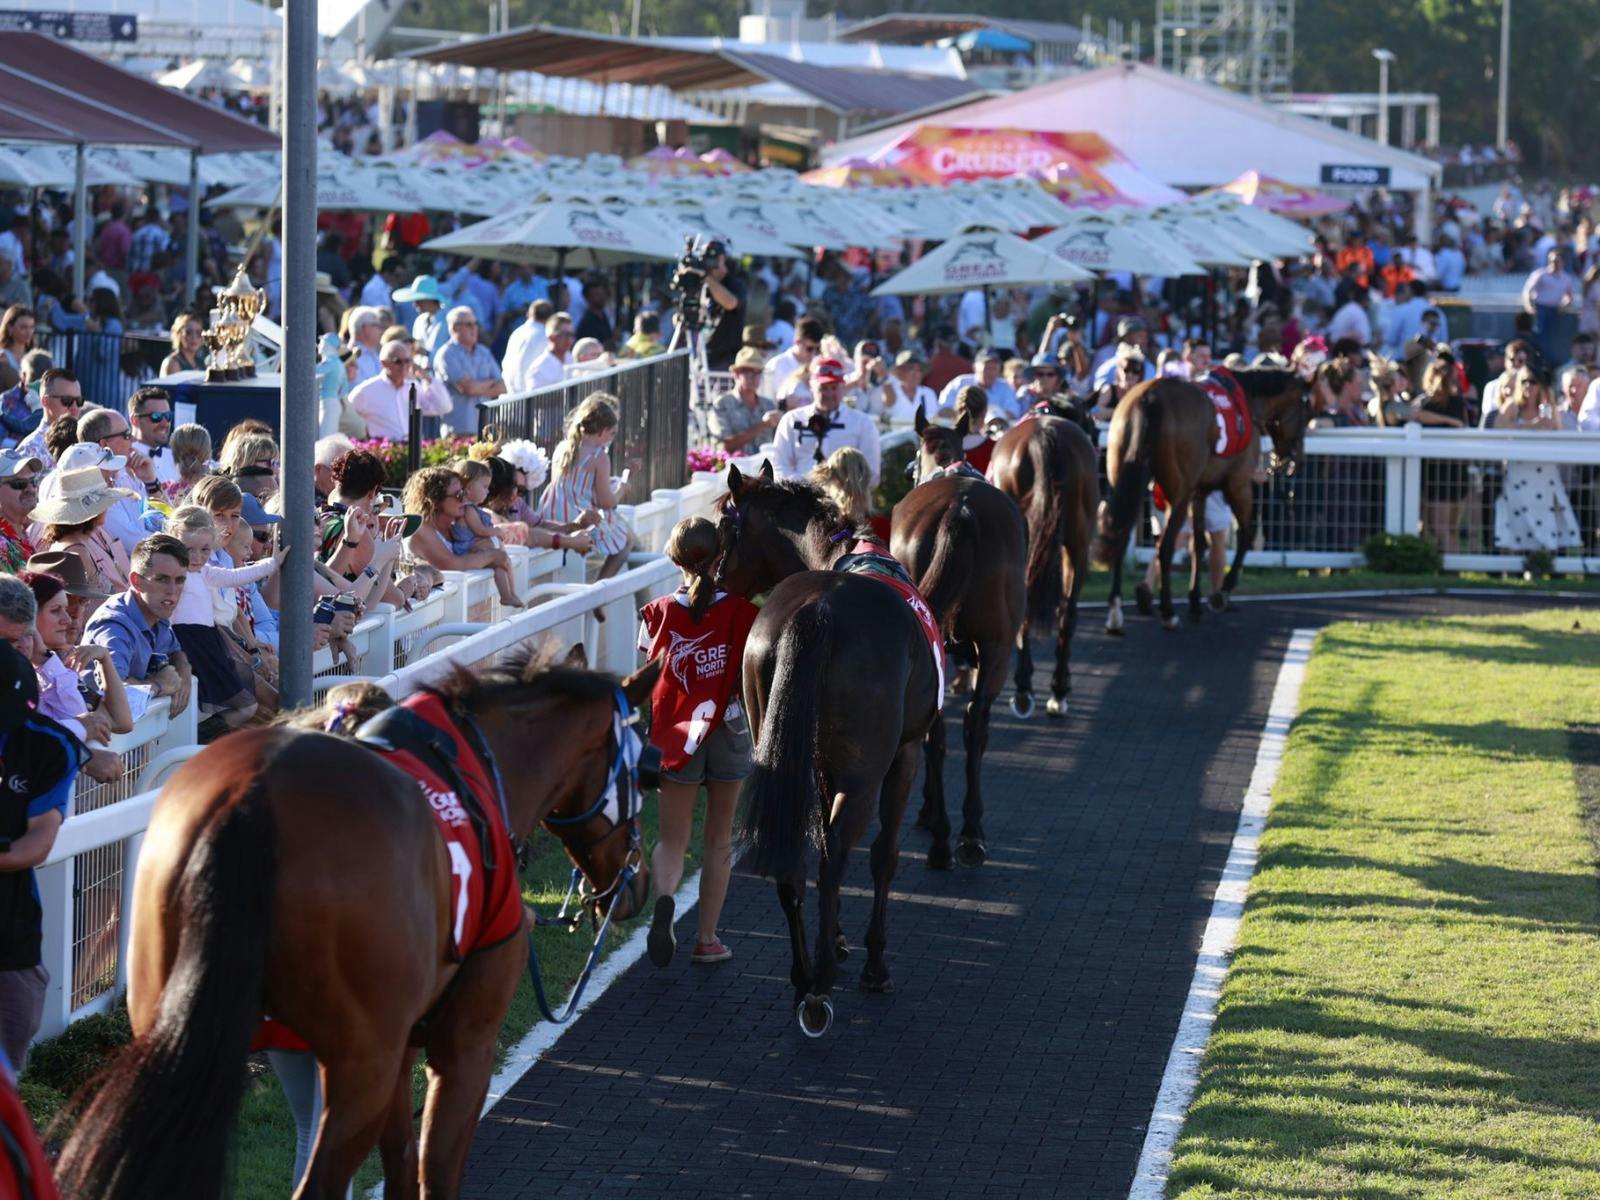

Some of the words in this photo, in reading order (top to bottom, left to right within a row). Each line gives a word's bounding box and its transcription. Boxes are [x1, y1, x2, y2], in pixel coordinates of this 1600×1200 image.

[932, 147, 1052, 174] CRUISER
[1332, 167, 1379, 184] FOOD
[695, 644, 727, 664] GRE
[683, 699, 718, 756] 6
